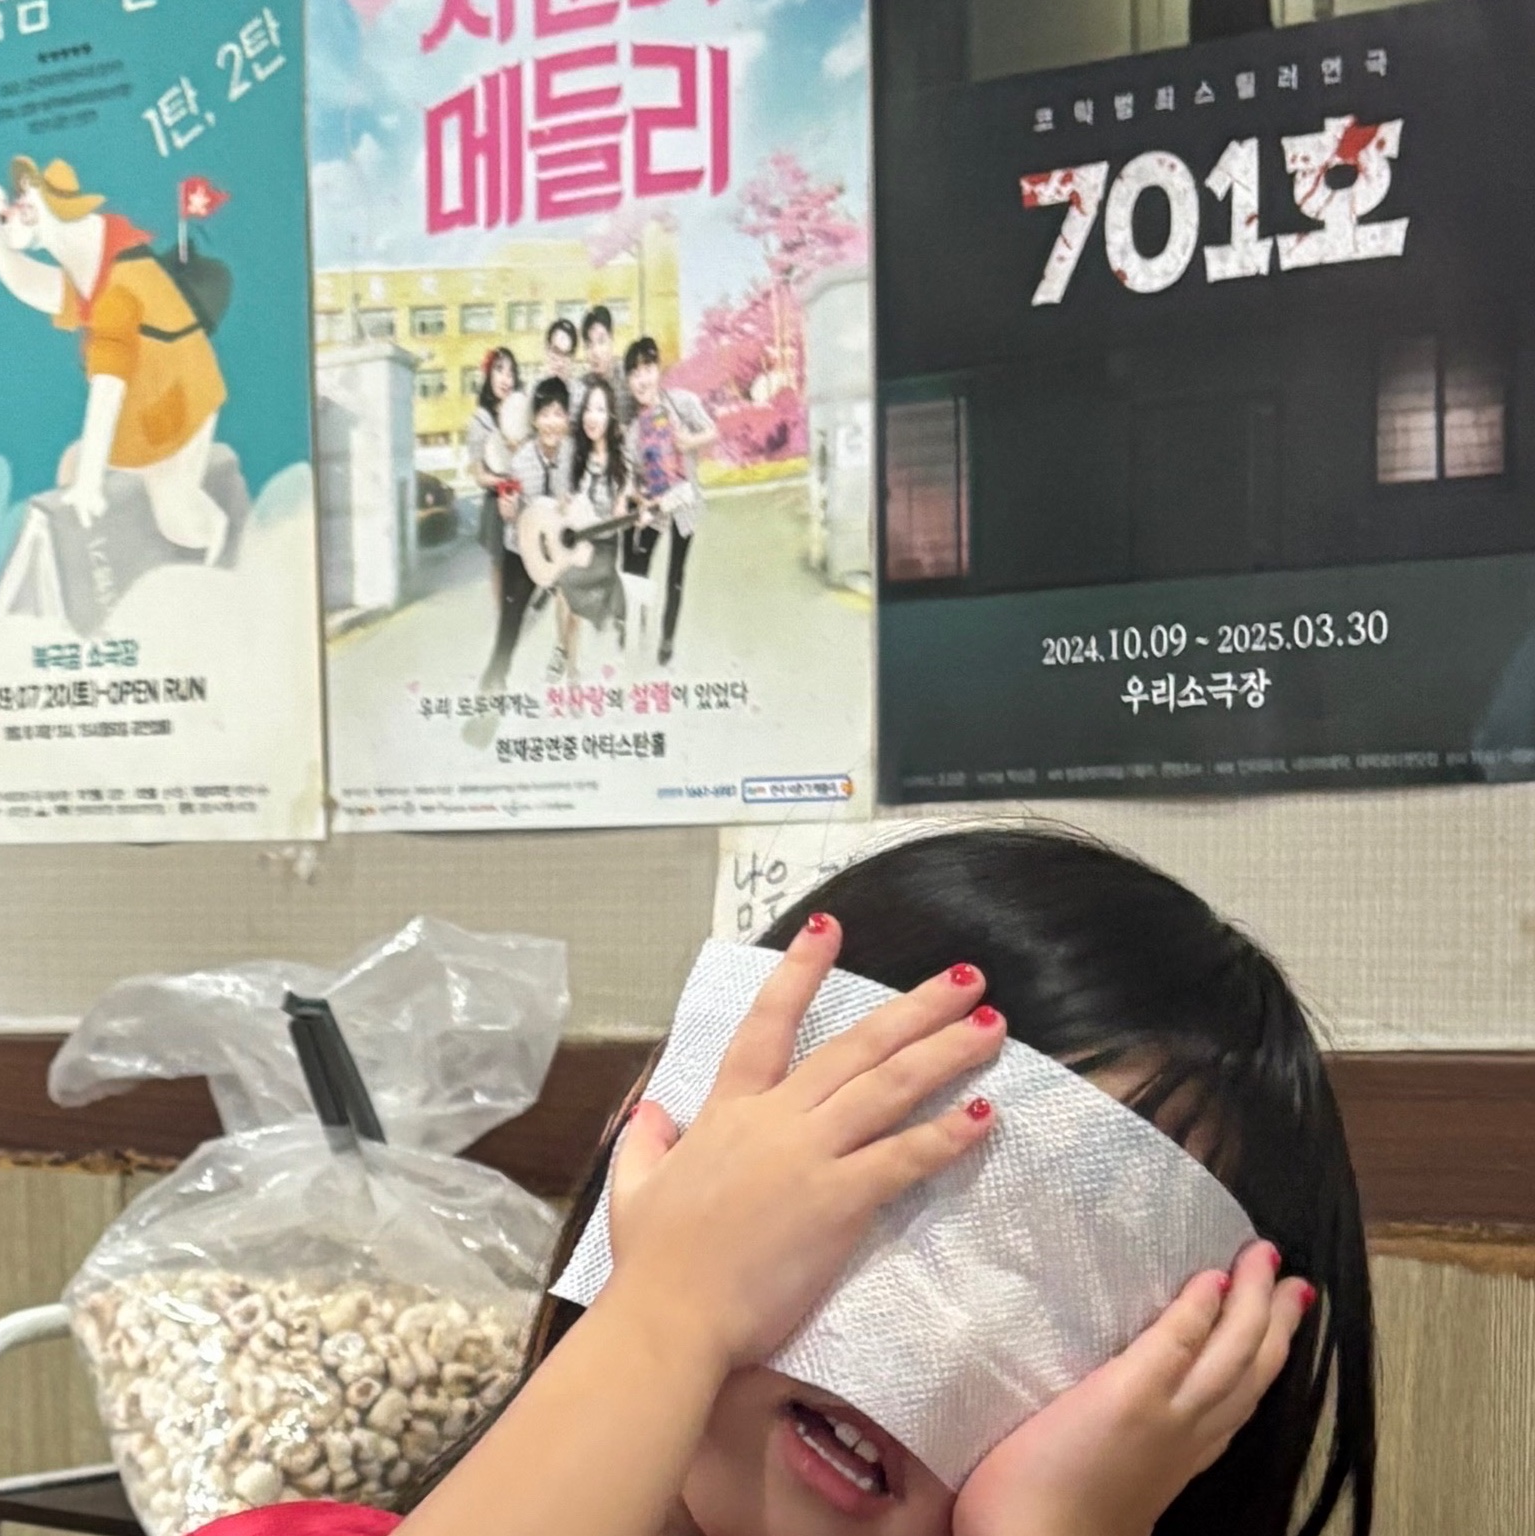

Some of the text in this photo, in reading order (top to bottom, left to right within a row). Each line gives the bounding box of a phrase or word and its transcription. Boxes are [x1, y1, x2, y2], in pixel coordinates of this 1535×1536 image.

[216, 7, 286, 102] 2탄
[425, 42, 731, 235] 메들리
[1019, 114, 1410, 307] 701호
[1041, 622, 1188, 666] 2024.10.09
[1216, 609, 1390, 655] 2025.03.30
[163, 677, 207, 702] RUN
[1120, 667, 1272, 715] 우리소극장
